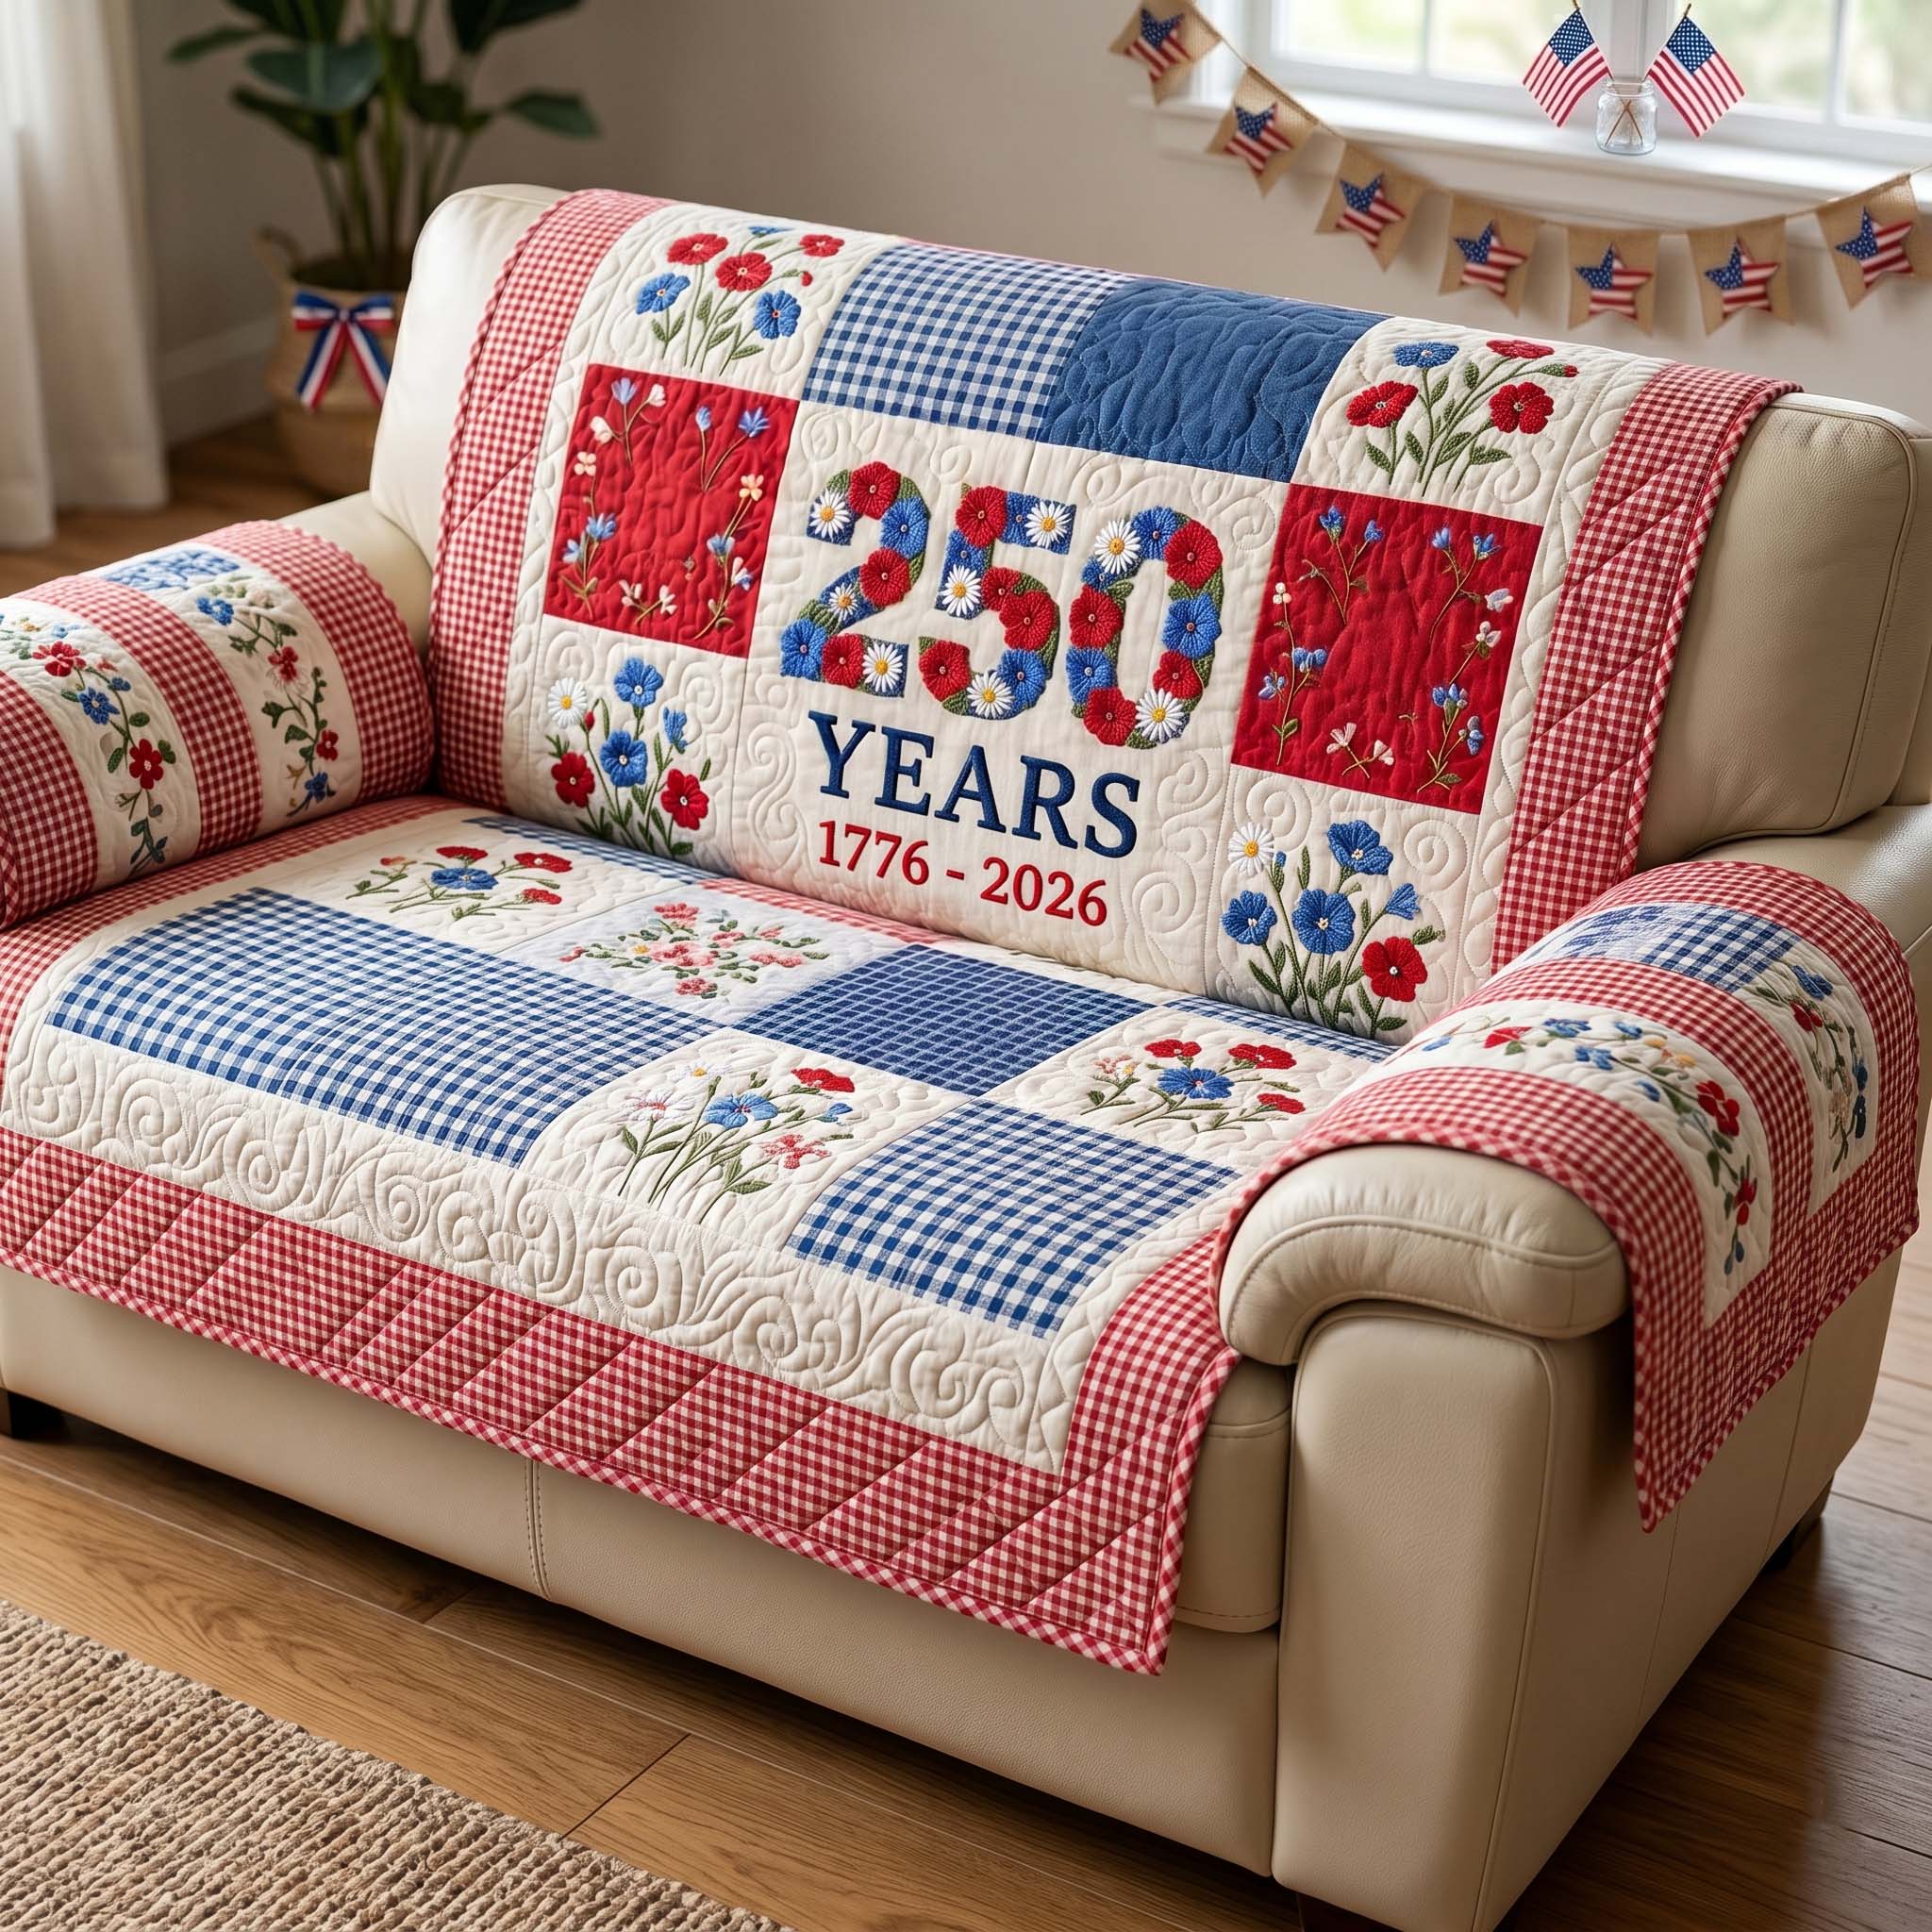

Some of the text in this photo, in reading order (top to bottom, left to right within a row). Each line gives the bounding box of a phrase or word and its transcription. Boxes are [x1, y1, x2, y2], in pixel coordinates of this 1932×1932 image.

[780, 460, 1224, 749] 250
[808, 710, 1141, 859] YEARS
[818, 820, 1108, 927] 1776 - 2026
